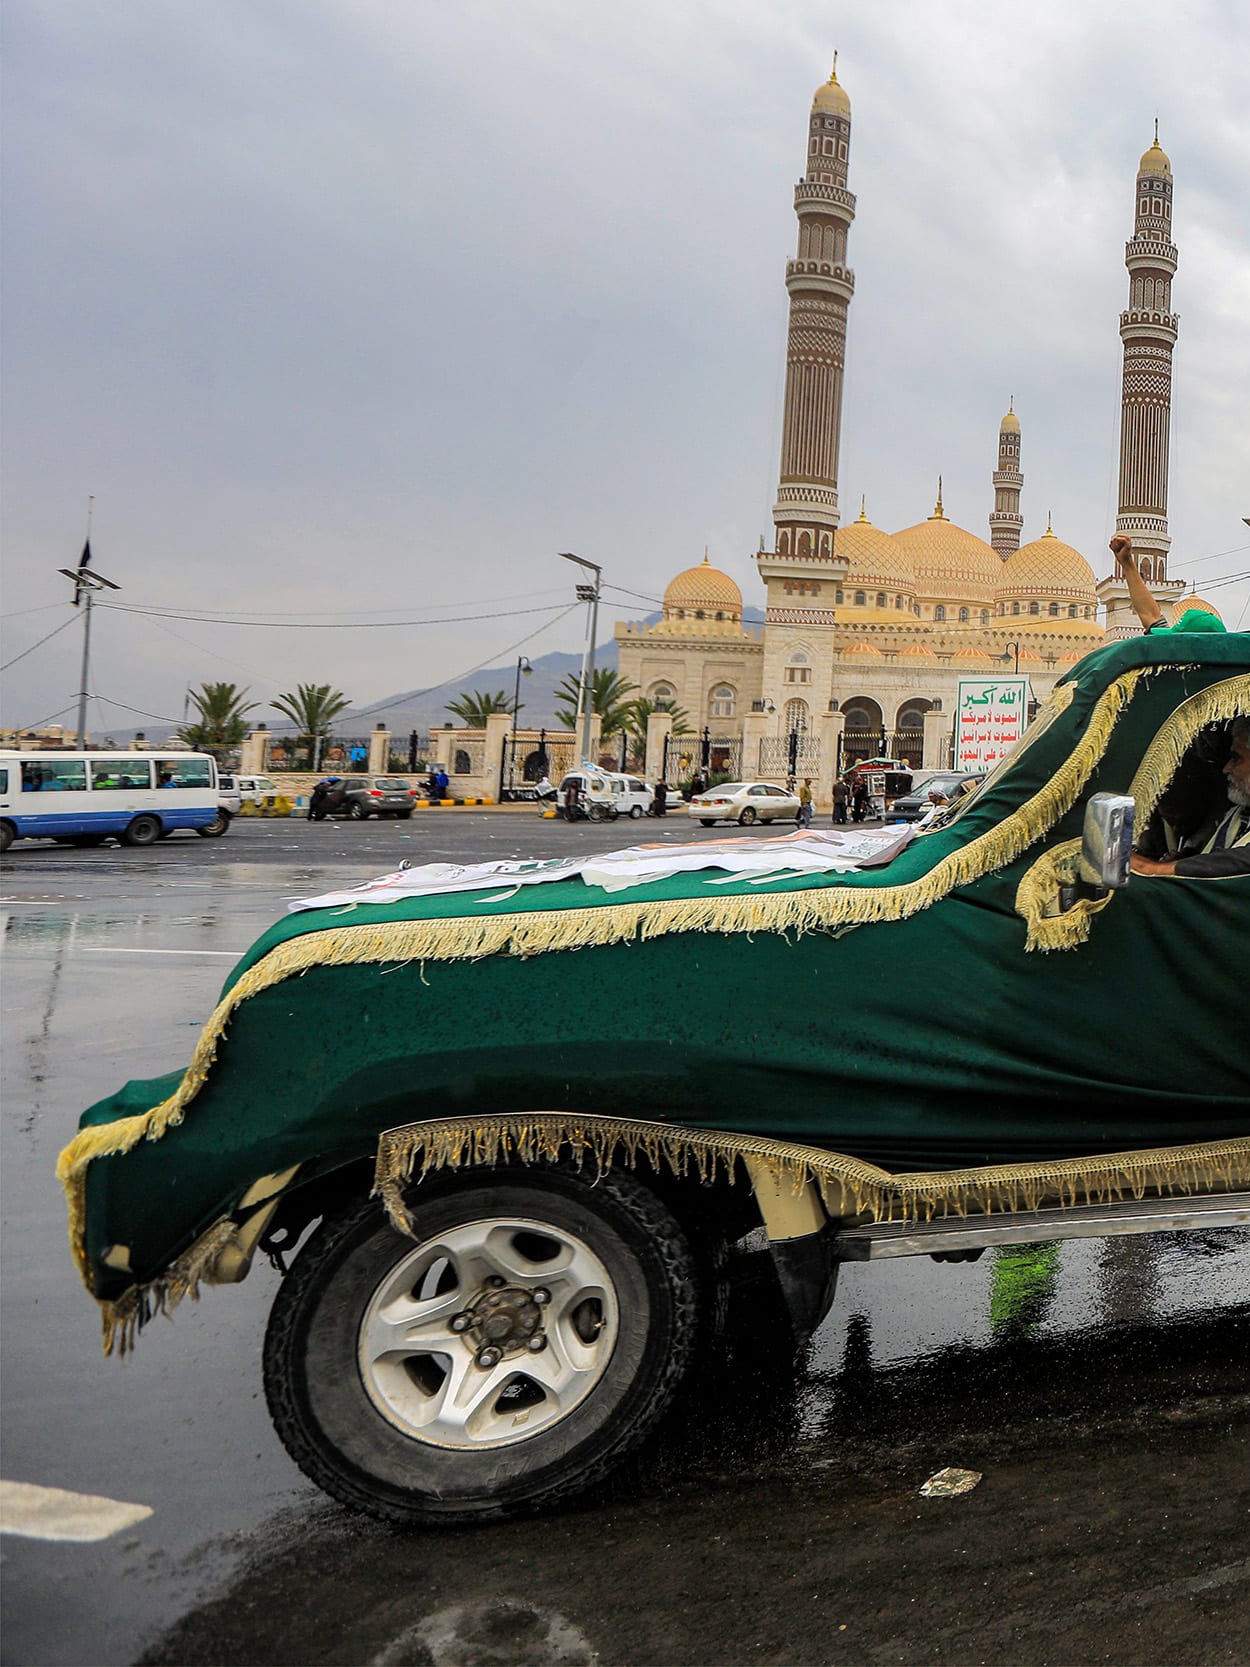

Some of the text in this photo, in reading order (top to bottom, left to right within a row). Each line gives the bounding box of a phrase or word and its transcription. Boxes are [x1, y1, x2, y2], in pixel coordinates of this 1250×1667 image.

[961, 685, 1022, 710] الله أكبر
[994, 711, 1021, 726] الموت
[993, 730, 1020, 744] الموت
[959, 747, 982, 762] اليهود
[983, 748, 996, 762] على
